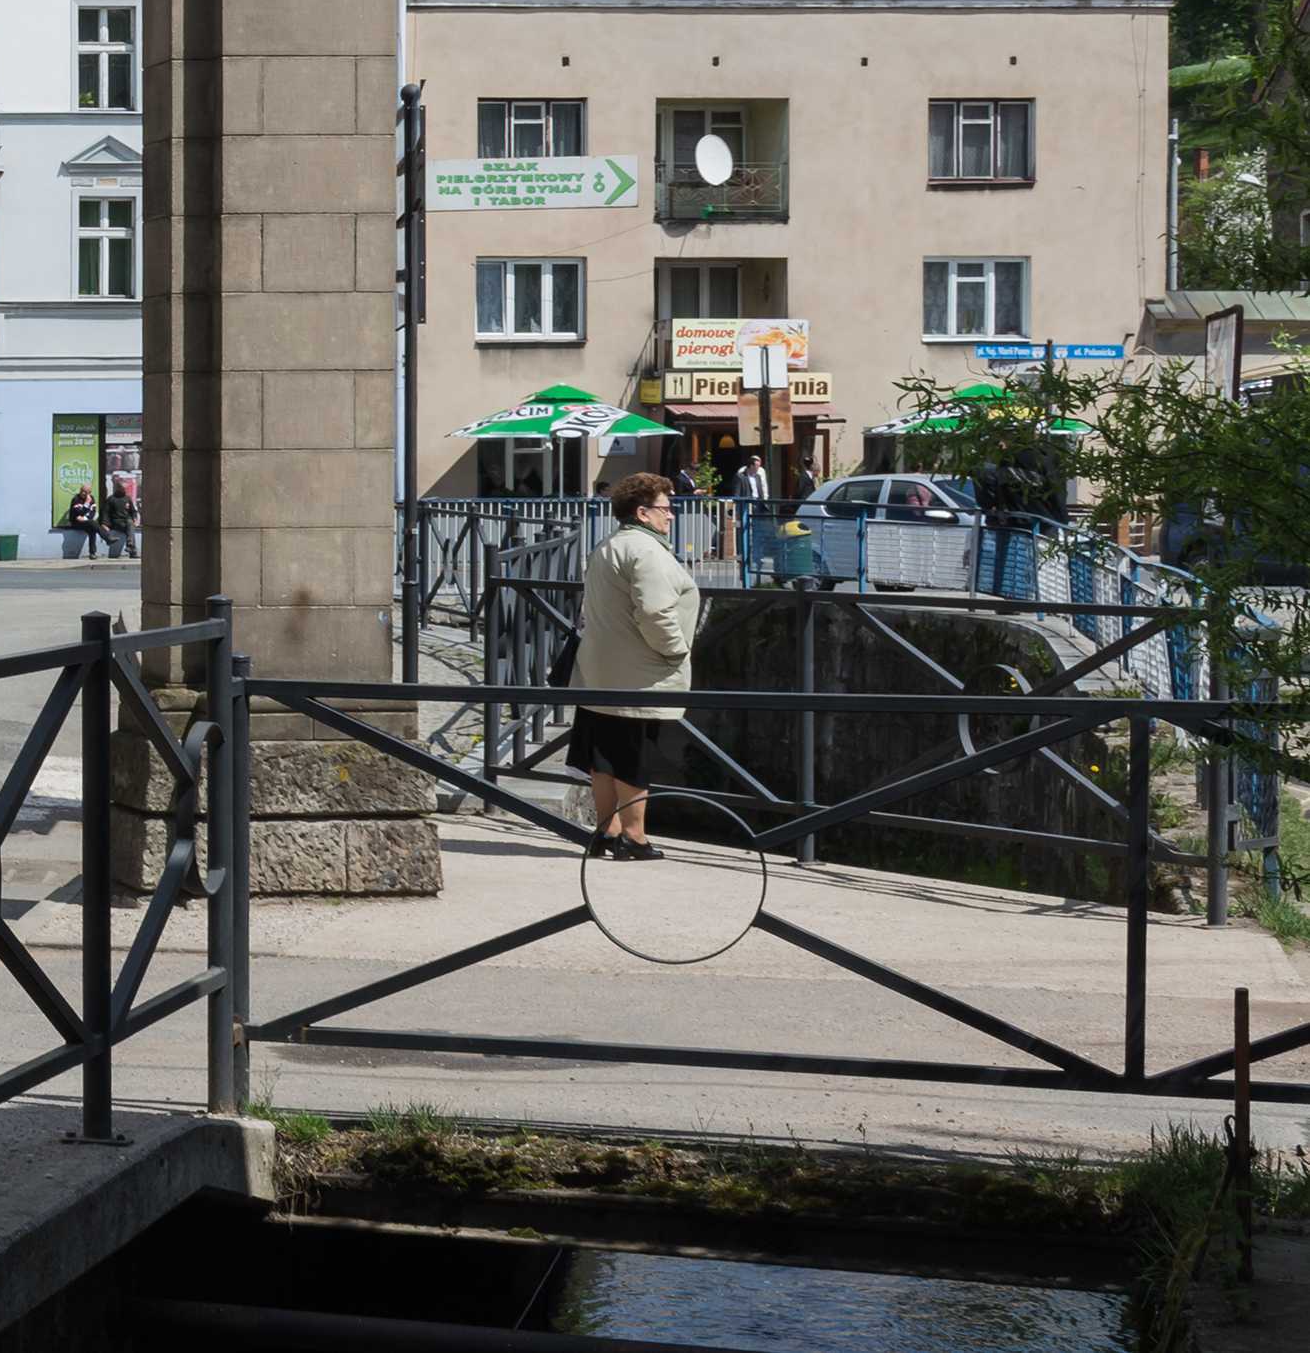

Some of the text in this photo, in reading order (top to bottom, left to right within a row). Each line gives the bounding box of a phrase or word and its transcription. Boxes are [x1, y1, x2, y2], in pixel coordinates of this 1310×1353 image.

[482, 162, 539, 172] SZLAK
[436, 173, 585, 184] PIELGRZYMKOWY
[438, 184, 583, 196] NA GÓRĘ SYNAJ
[474, 196, 546, 206] I TABOR
[675, 326, 735, 338] domowe
[676, 341, 735, 357] pierogi
[59, 467, 93, 478] Ekstra
